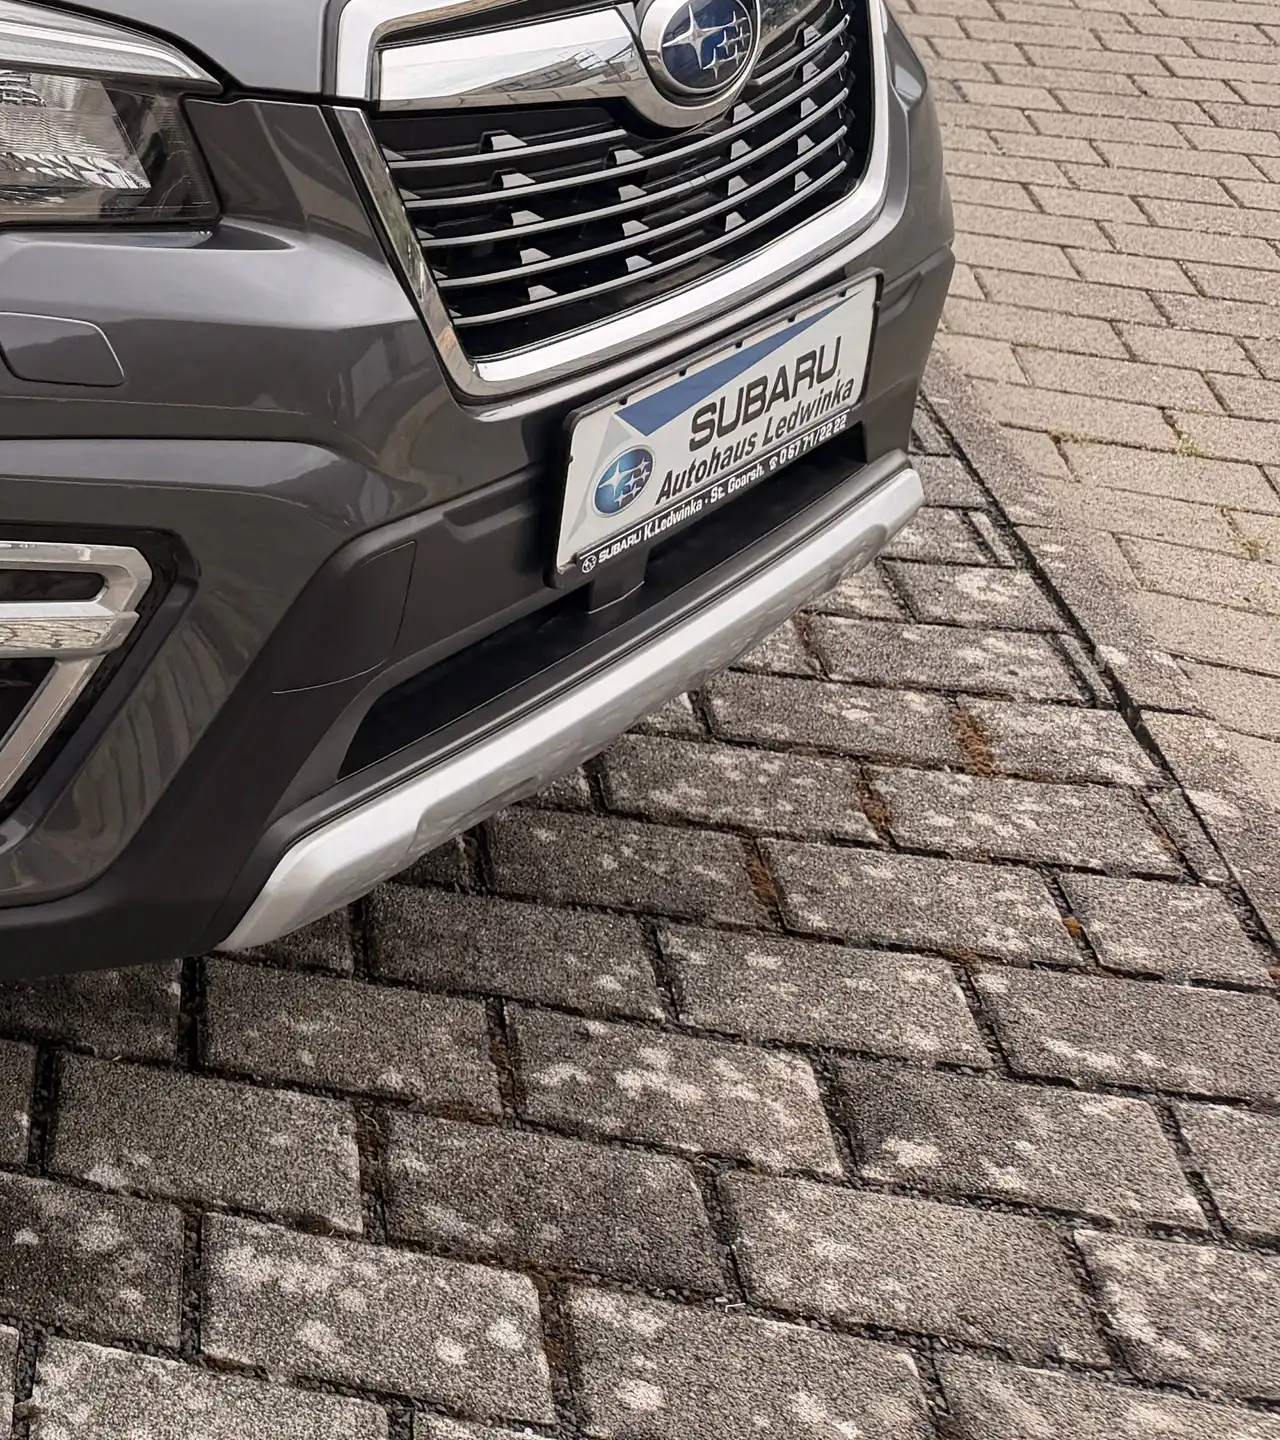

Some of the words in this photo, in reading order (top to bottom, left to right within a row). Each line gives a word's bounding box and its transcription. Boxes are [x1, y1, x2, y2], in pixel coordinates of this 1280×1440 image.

[654, 430, 759, 506] Autohaus
[761, 377, 855, 448] Ledwinka
[689, 335, 842, 452] SUBARU
[598, 530, 643, 564] SUBARU
